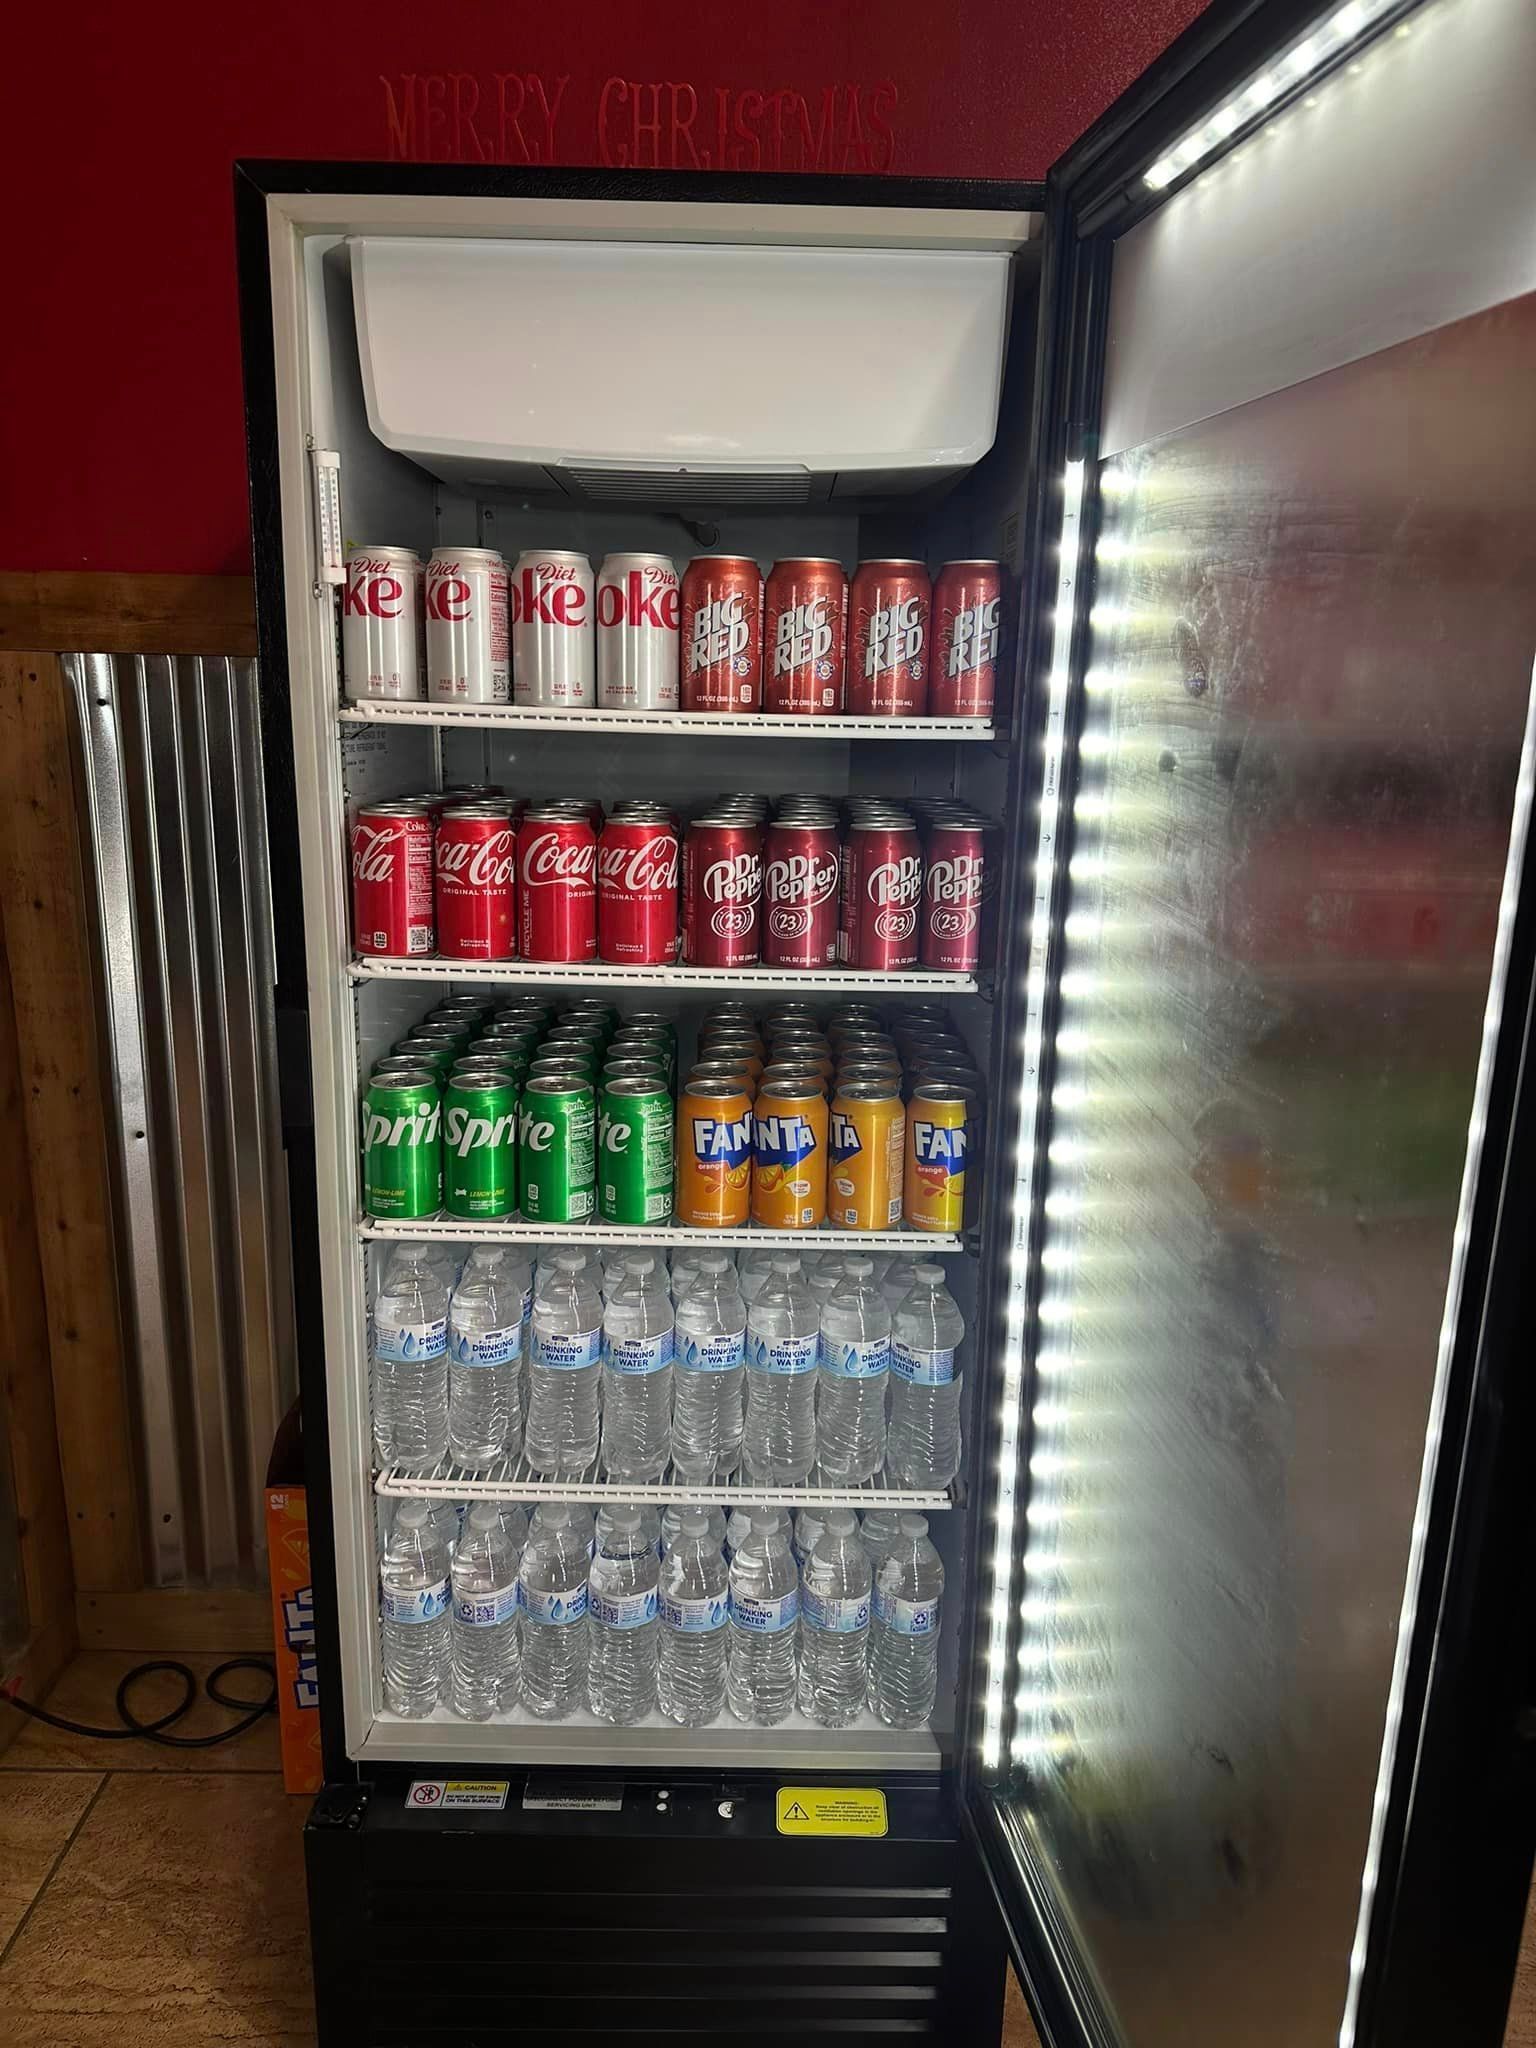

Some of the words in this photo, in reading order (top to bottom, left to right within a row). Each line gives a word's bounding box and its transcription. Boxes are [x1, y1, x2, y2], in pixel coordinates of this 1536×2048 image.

[379, 73, 571, 163] MERRY
[600, 77, 898, 171] CHRISTMAS
[354, 557, 391, 574] Diet
[428, 560, 460, 577] Diet
[536, 562, 576, 581] Diet
[694, 592, 743, 642] BIG
[777, 596, 827, 646] BIG
[869, 596, 919, 645] BIG
[953, 596, 1000, 645] BIG
[691, 621, 749, 673] RED
[774, 625, 832, 678] RED
[865, 625, 923, 678] RED
[735, 853, 759, 881] Dr
[788, 855, 820, 881] Dr
[900, 856, 920, 882] Dr
[954, 855, 983, 882] Dr
[766, 861, 834, 904] Pepper
[442, 887, 479, 896] ORIGINAL
[482, 888, 507, 897] TASTE
[724, 913, 742, 930] 23
[780, 914, 797, 931] 23
[889, 915, 906, 932] 23
[942, 914, 959, 931] 23
[754, 1116, 814, 1152] NTA
[917, 1166, 943, 1175] orange
[472, 1338, 514, 1352] DRINKING
[540, 1343, 583, 1354] DRINKING
[701, 1344, 741, 1356] DRINKING
[770, 1348, 812, 1358] DRINKING
[479, 1349, 509, 1360] WATER
[545, 1353, 576, 1362] WATER
[613, 1349, 655, 1360] DRINKING
[618, 1358, 649, 1367] WATER
[739, 1613, 766, 1625] WATER
